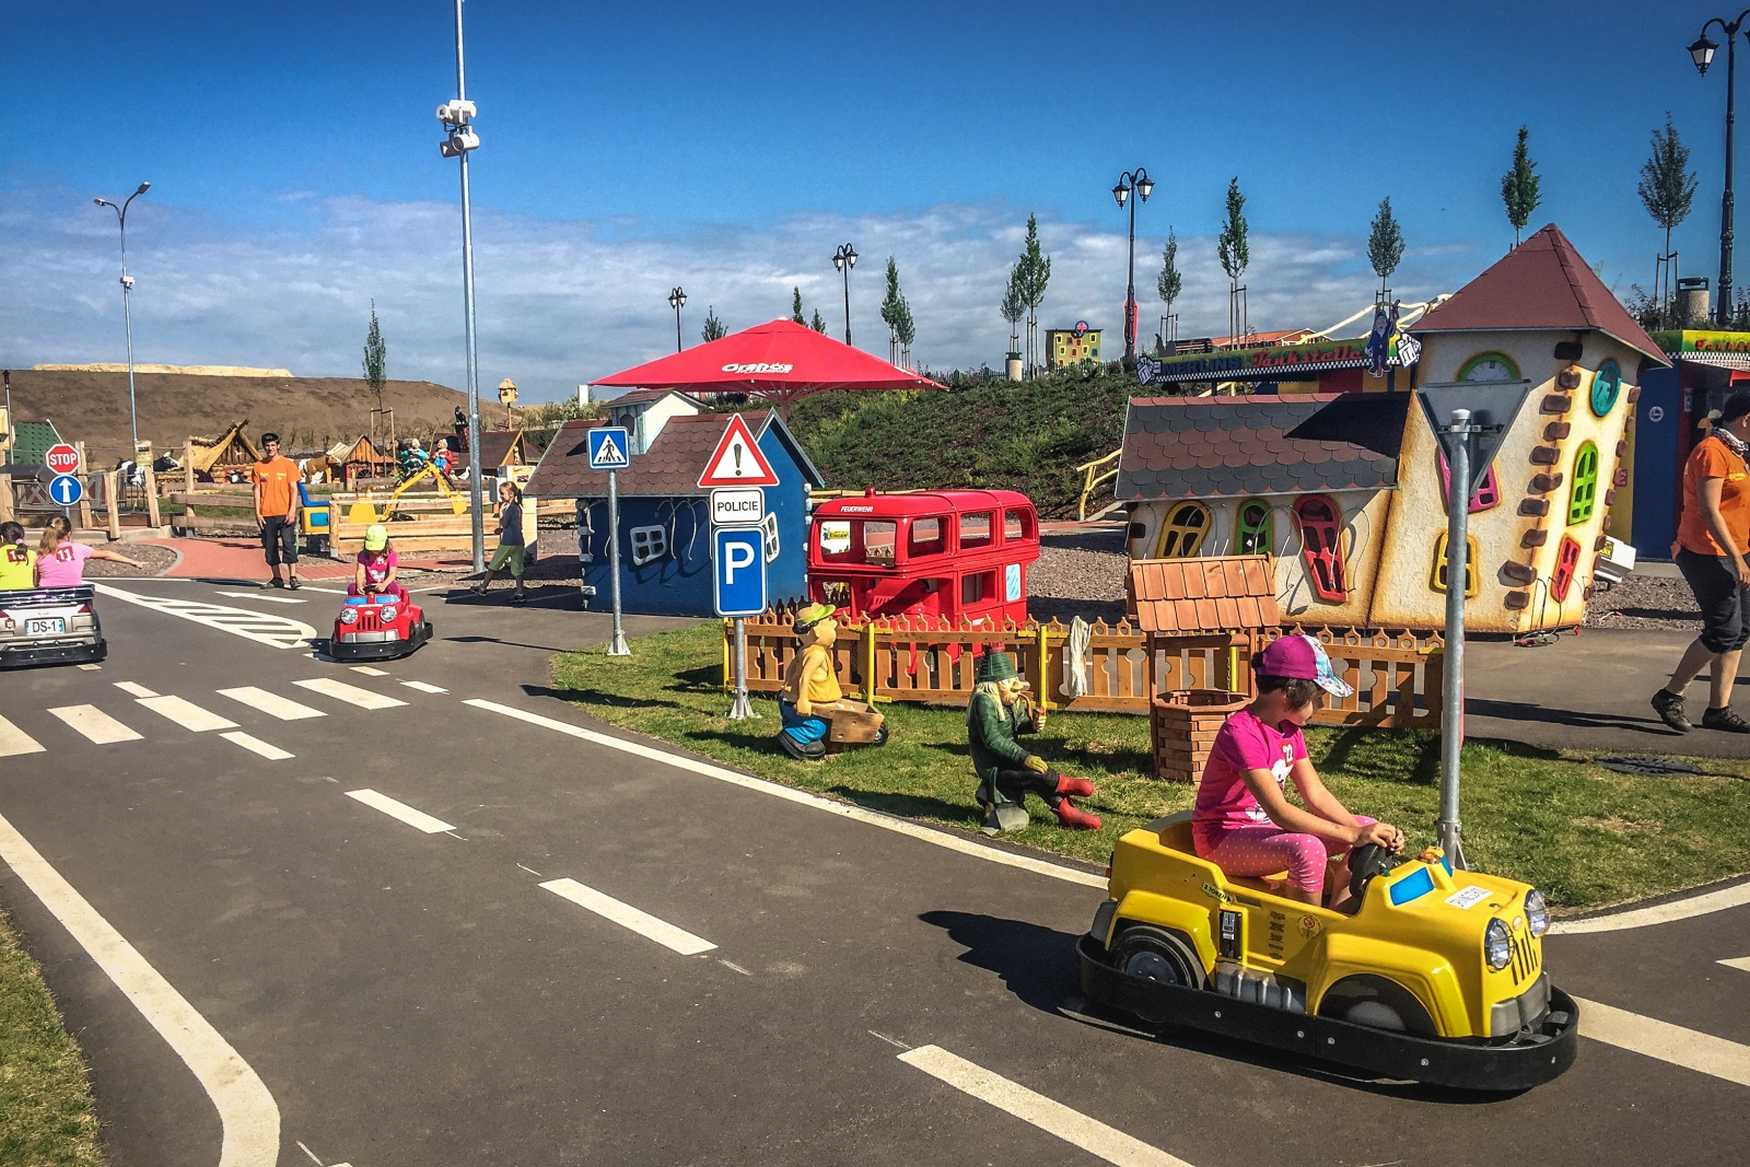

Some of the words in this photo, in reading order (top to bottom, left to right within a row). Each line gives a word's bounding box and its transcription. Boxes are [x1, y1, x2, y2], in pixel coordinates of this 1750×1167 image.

[49, 453, 77, 466] STOP
[716, 500, 759, 512] POLICIE
[57, 550, 72, 562] 11
[724, 541, 755, 585] P
